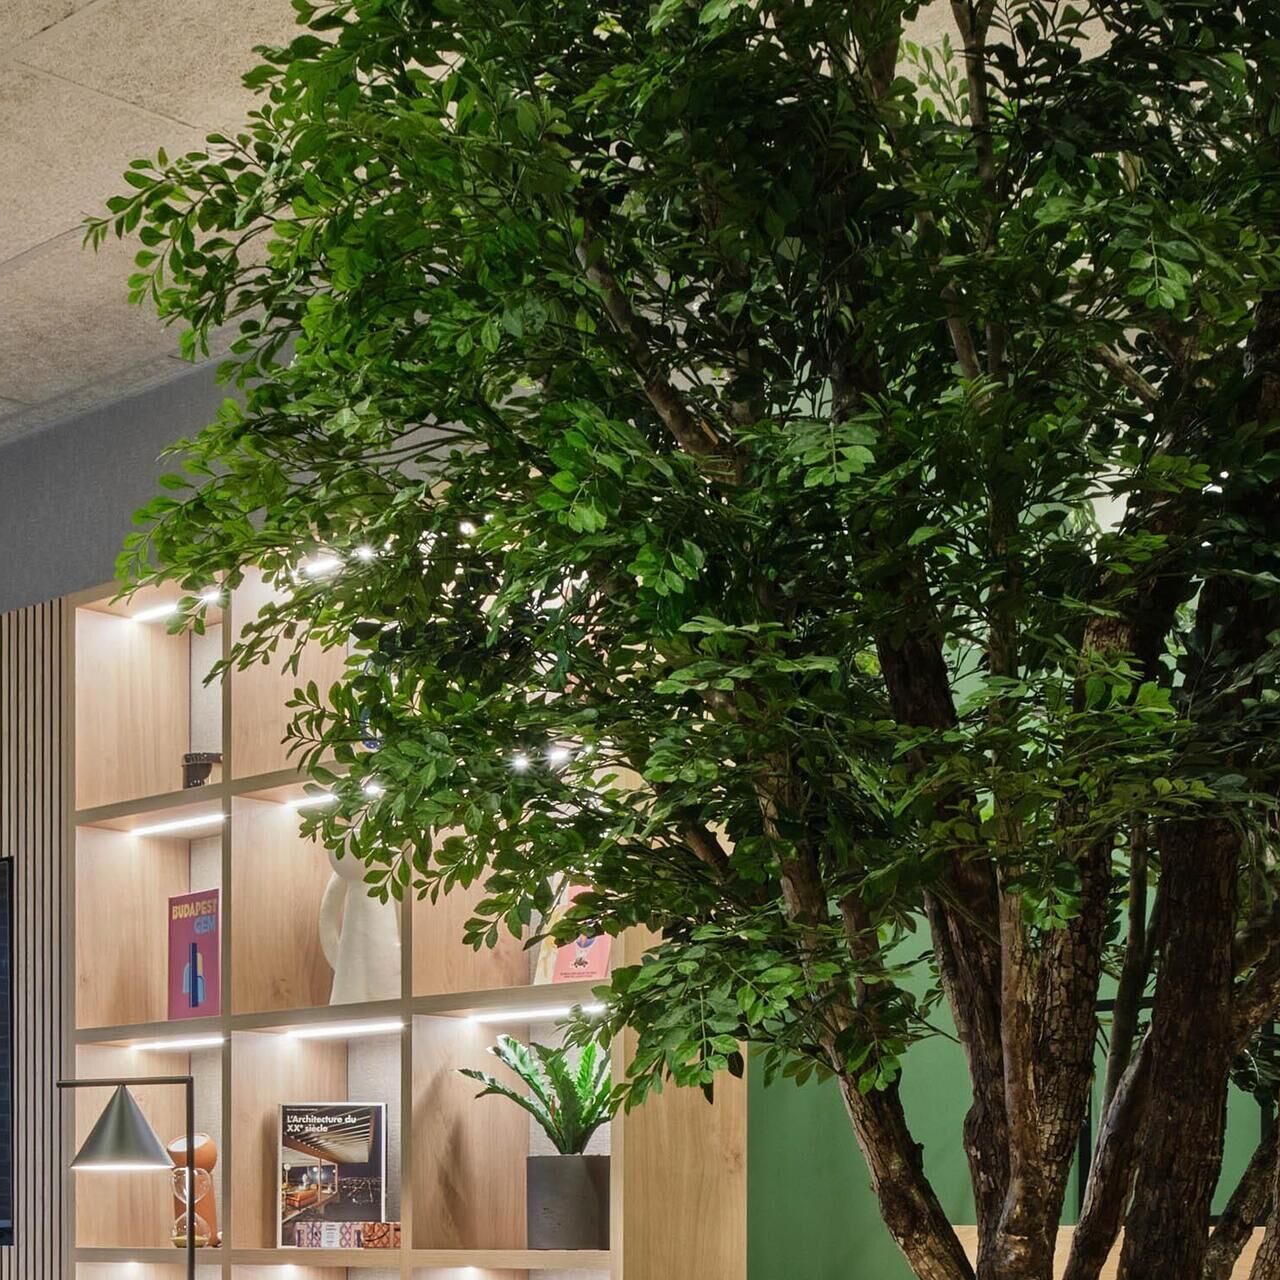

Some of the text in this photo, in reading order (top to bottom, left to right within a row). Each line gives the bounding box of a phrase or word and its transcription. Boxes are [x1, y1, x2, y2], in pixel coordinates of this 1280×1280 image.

[172, 898, 217, 920] BUDAPEST
[286, 1115, 357, 1124] L'Architecture du
